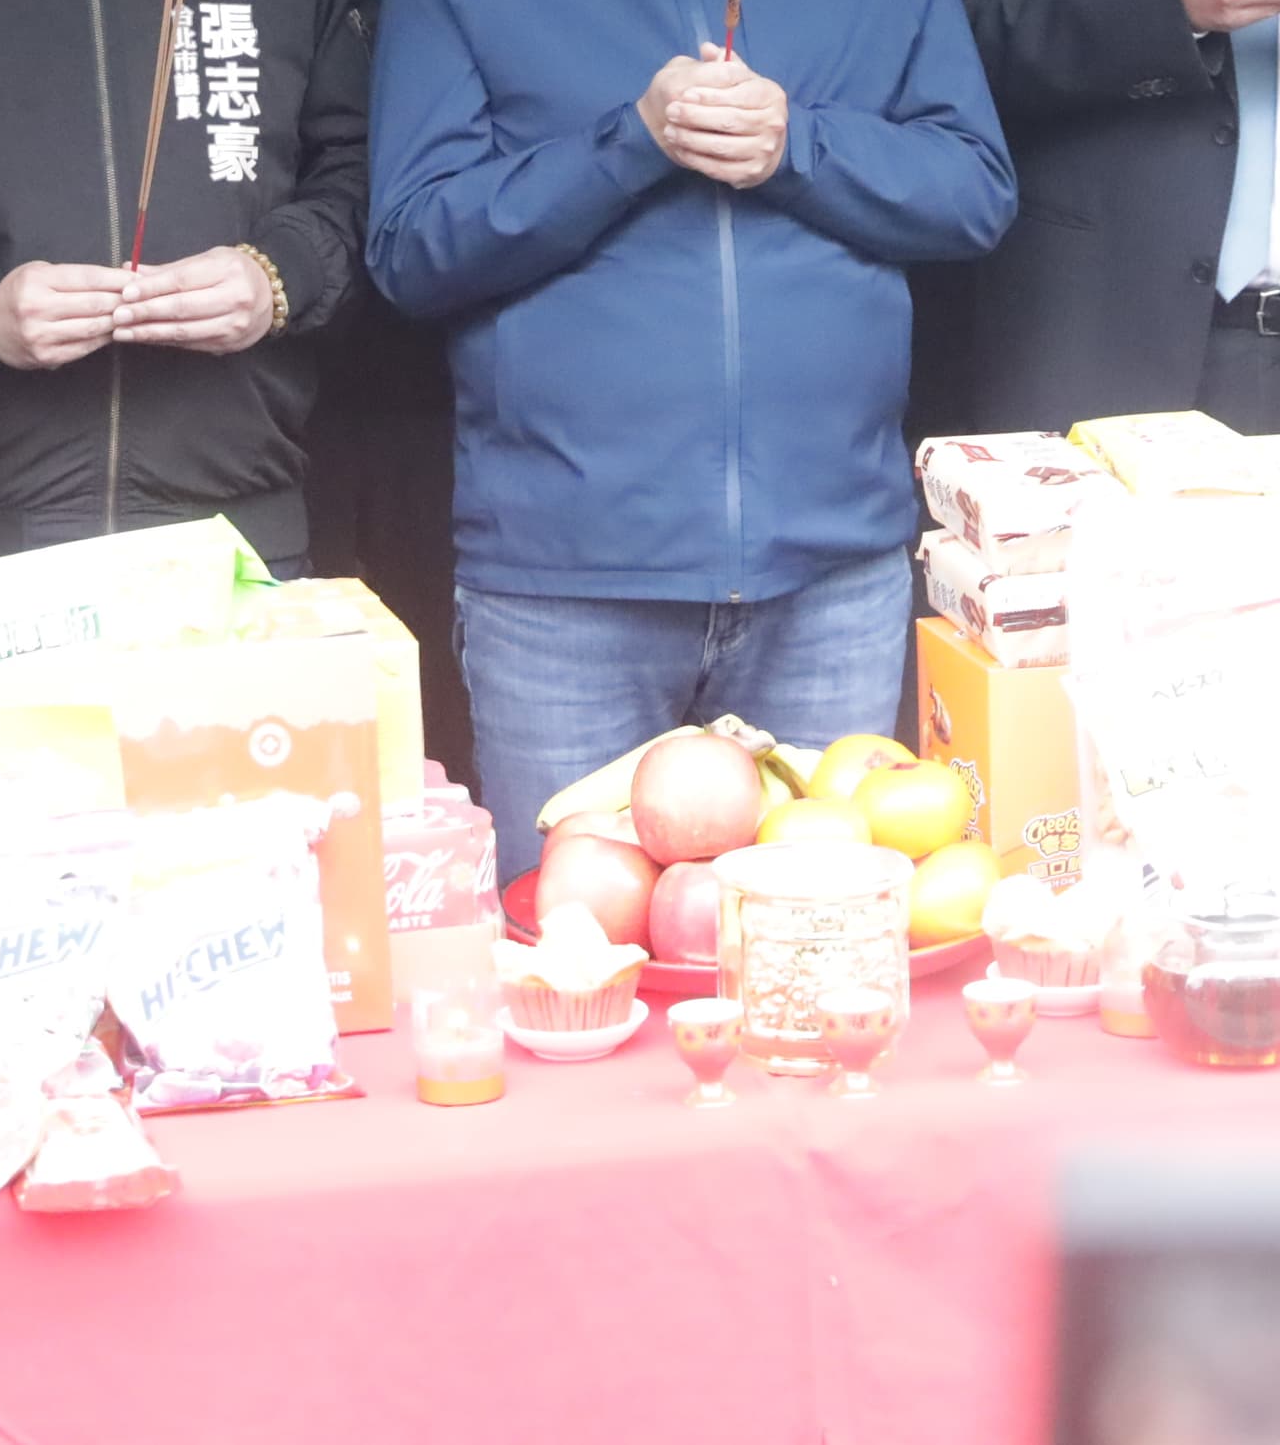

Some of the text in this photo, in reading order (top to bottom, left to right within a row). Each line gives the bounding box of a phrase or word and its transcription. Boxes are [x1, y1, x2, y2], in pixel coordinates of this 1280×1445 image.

[171, 5, 201, 121] 台北市議員
[199, 3, 261, 183] 張志豪
[1025, 809, 1081, 844] Cheeto
[388, 914, 433, 930] ASTE
